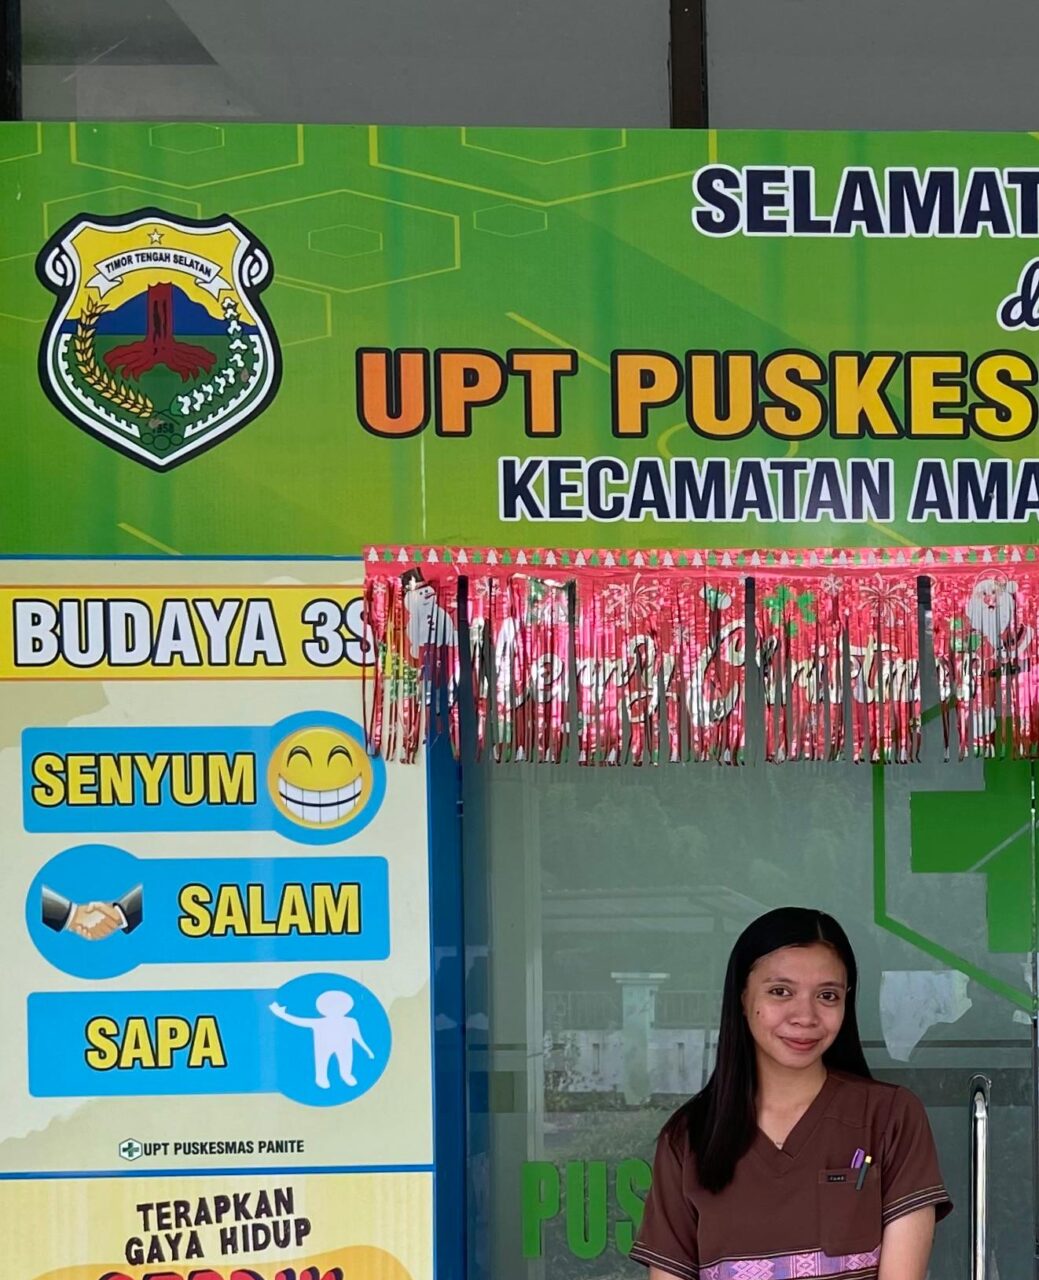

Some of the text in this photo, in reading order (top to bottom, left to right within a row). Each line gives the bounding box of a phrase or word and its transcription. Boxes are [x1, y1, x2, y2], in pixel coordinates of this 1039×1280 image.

[105, 252, 212, 277] TIMOR TENGAH SELATAN
[356, 347, 579, 438] UPT
[500, 456, 894, 521] KECAMATAN
[13, 598, 286, 667] BUDAYA
[32, 752, 256, 808] SENYUM
[177, 882, 362, 937] SALAM
[85, 1015, 228, 1071] SAPA
[144, 1139, 304, 1156] UPT PUSKESMAS PANITE
[137, 1187, 294, 1232] TERAPKAN
[125, 1216, 312, 1266] GAYA HIDUP
